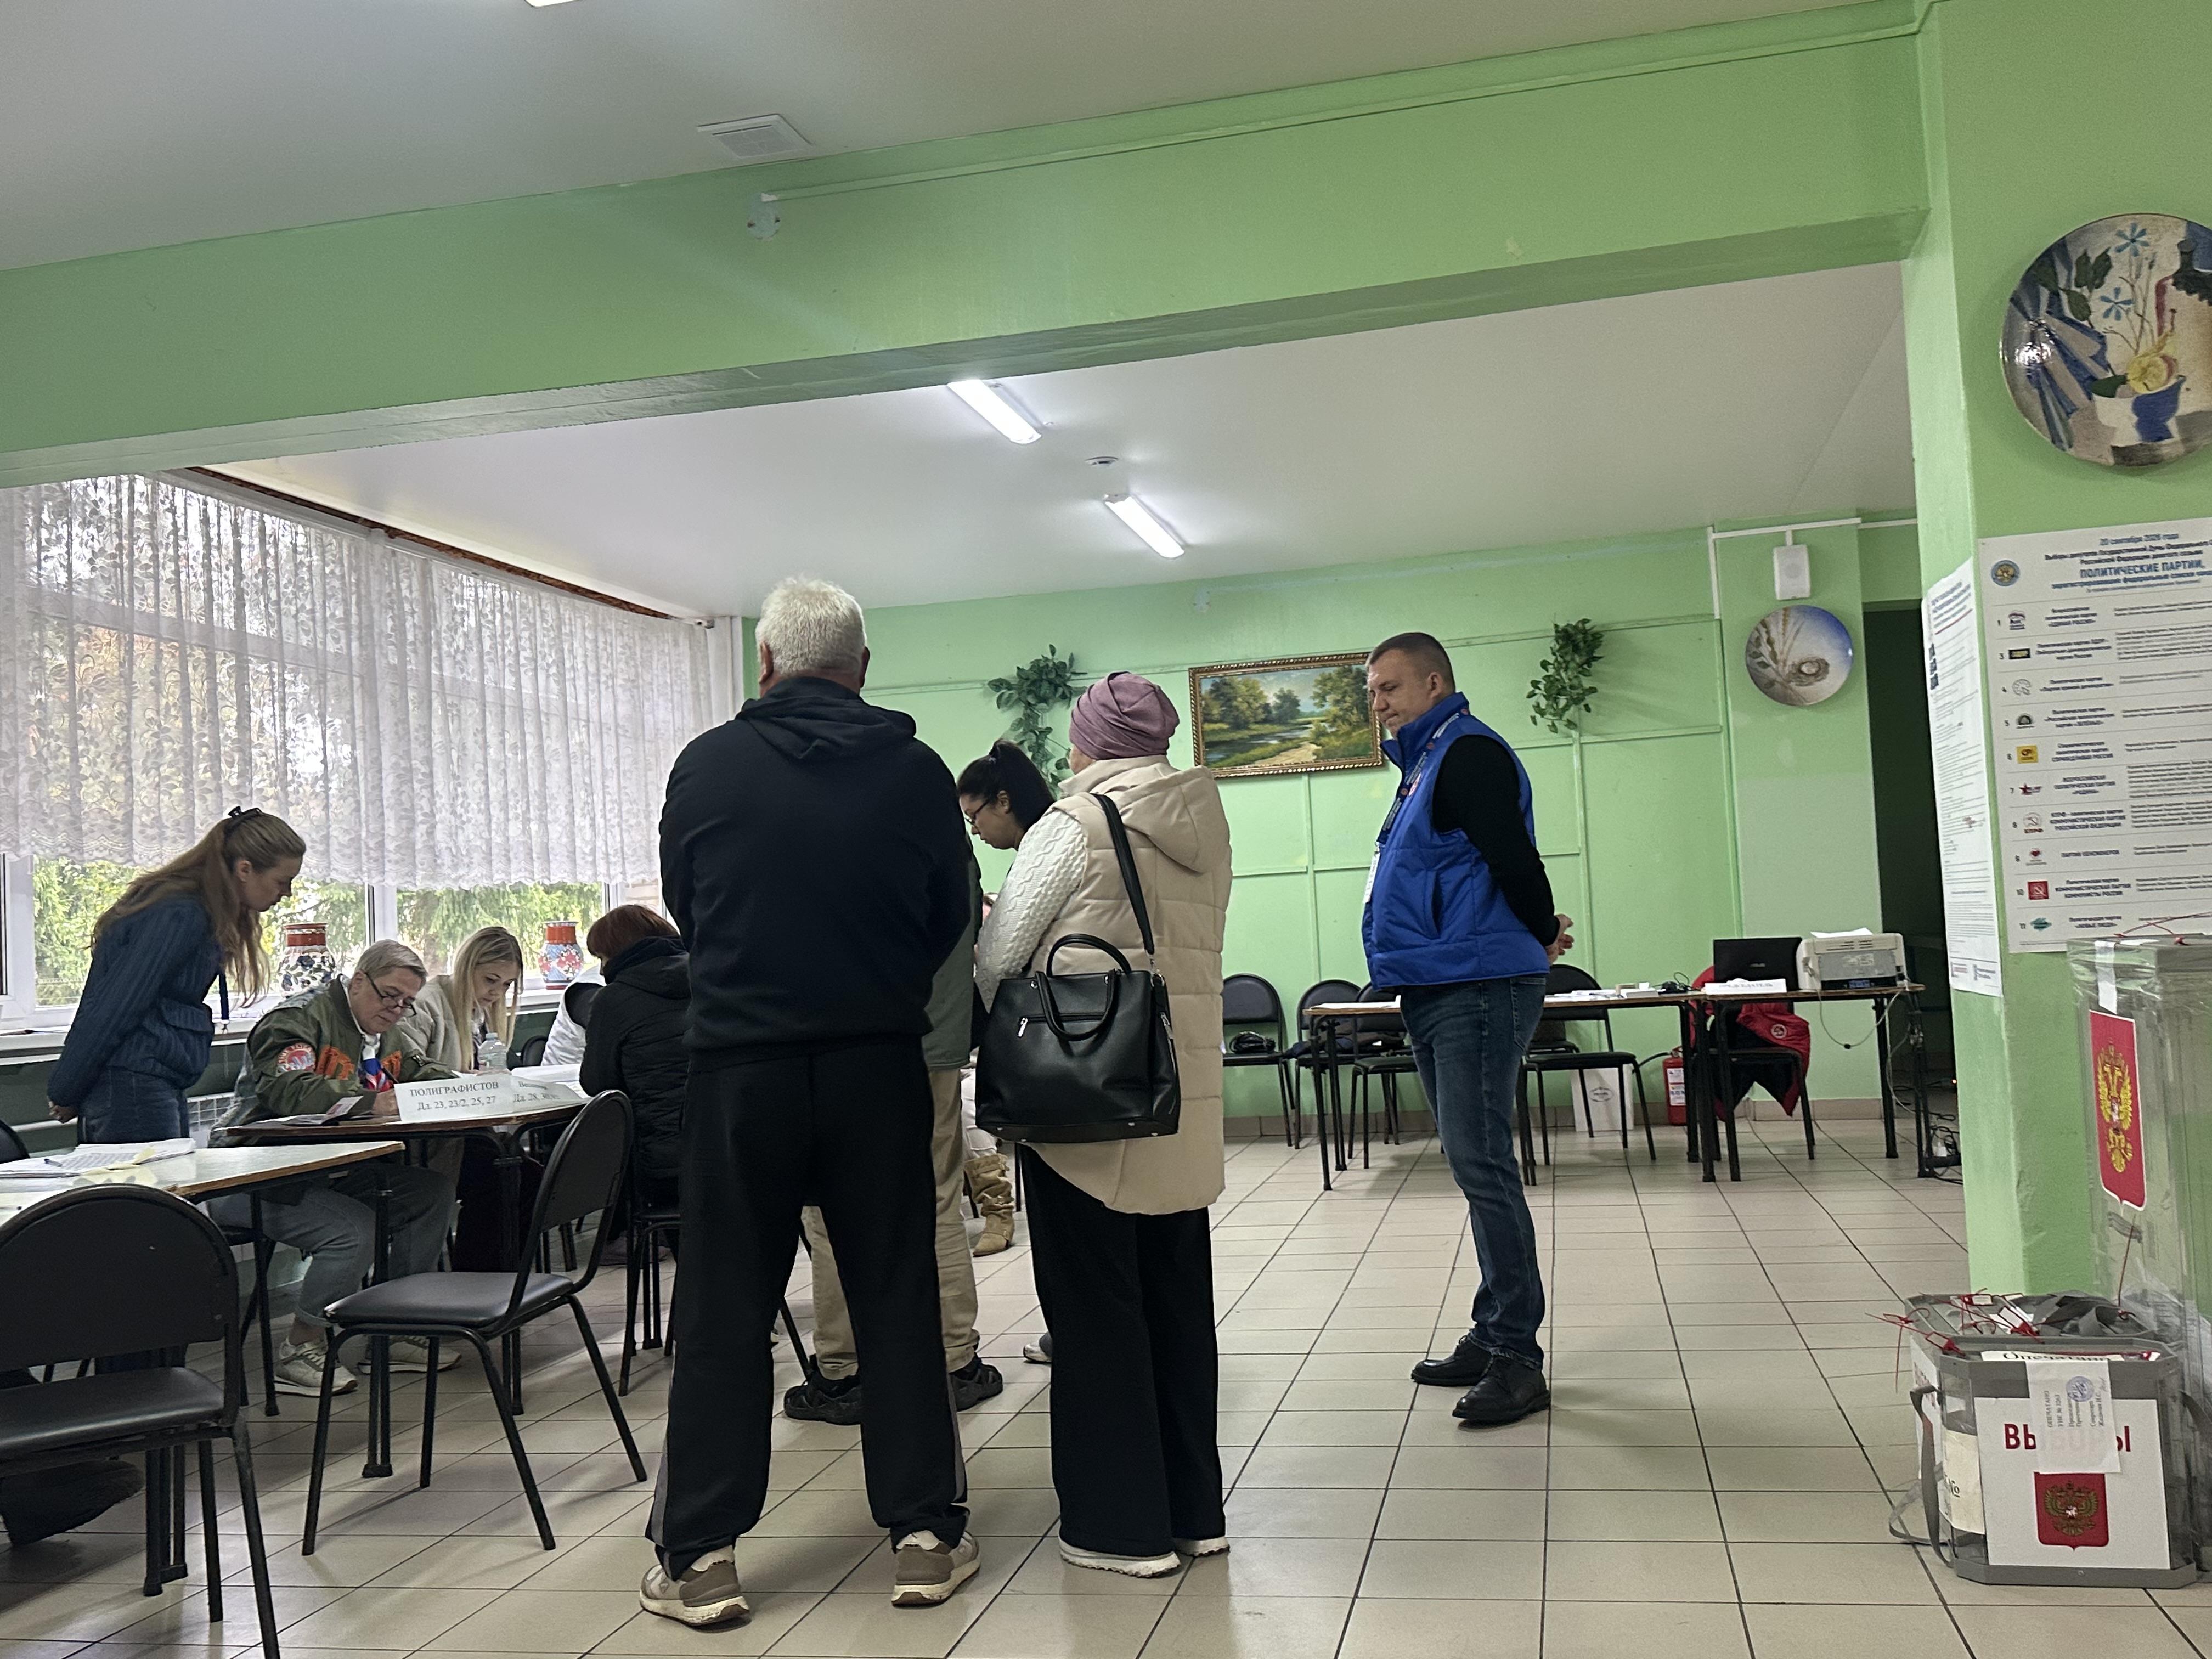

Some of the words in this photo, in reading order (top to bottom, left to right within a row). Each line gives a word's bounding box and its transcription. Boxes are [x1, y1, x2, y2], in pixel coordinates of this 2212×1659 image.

[2080, 563, 2159, 579] ПОЛИТИЧЕСКИЕ
[410, 1081, 499, 1097] ПОЛИГРАФИСТОВ
[434, 1101, 447, 1109] 23,
[471, 1097, 485, 1106] 25,
[487, 1096, 496, 1104] 27
[2004, 1424, 2131, 1452] ВЫЫ
